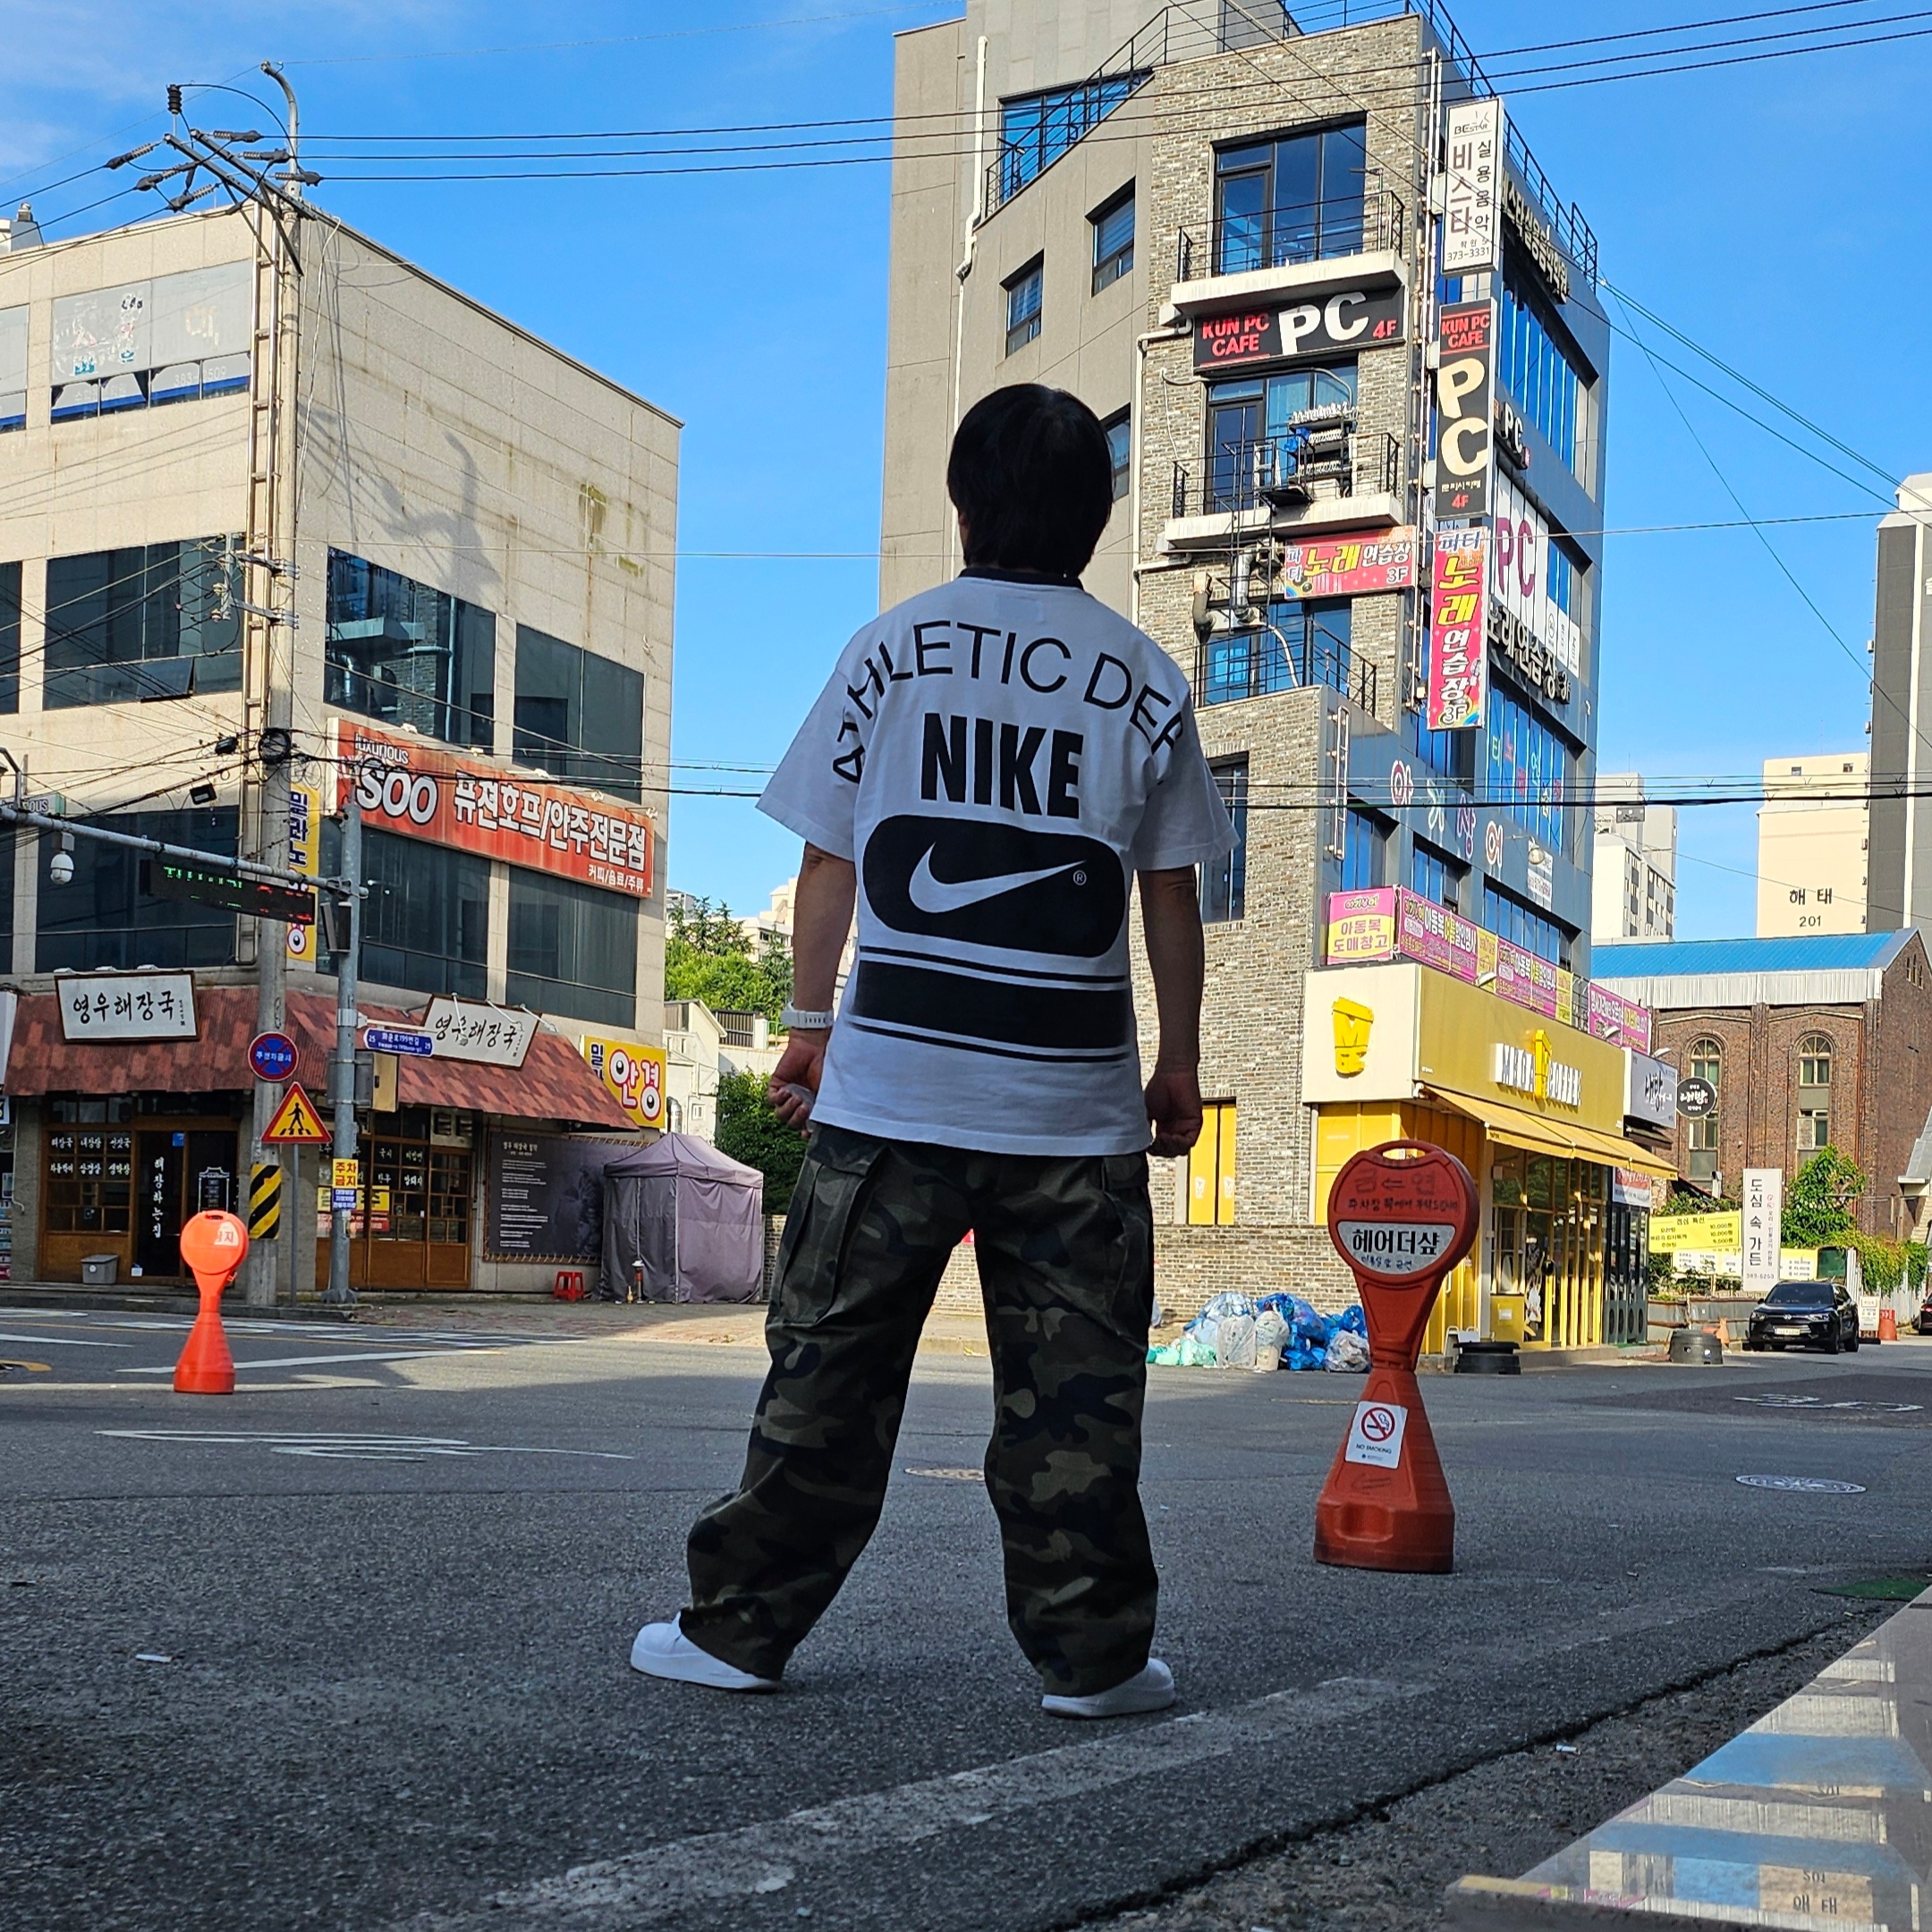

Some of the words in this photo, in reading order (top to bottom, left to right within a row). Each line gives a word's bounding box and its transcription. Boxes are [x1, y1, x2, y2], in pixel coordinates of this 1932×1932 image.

[1451, 141, 1473, 234] 비스타
[1446, 246, 1490, 262] 373-3331
[1202, 318, 1240, 339] KUN
[1244, 314, 1270, 333] PC
[1278, 291, 1369, 355] PC
[1373, 319, 1397, 340] 4F
[1442, 319, 1469, 335] KUN
[1471, 314, 1490, 331] PC
[1212, 334, 1259, 357] CAFE
[1448, 330, 1484, 348] CAFE
[1437, 358, 1488, 476] PC
[1504, 402, 1524, 454] PC
[1452, 494, 1470, 508] 4F
[1437, 530, 1481, 552] 파티
[1496, 516, 1537, 597] PC
[1385, 565, 1410, 584] 3F
[832, 620, 1072, 784] ATHLETIC
[1443, 702, 1469, 723] 3F
[355, 732, 410, 765] luxurious
[920, 712, 1084, 819] NIKE
[355, 758, 438, 826] SOO
[1789, 887, 1833, 905] 해태
[1341, 918, 1382, 936] 아동복
[1799, 915, 1821, 928] 201
[1333, 934, 1389, 953] 도매창고
[72, 990, 175, 1024] 영우해장국
[609, 1047, 662, 1123] 안경
[335, 1162, 357, 1174] 주차
[335, 1174, 357, 1187] 금지
[1750, 1178, 1763, 1208] 도심
[1750, 1215, 1762, 1230] 속
[1352, 1228, 1441, 1256] 헤어더샵
[1749, 1236, 1763, 1267] 가든
